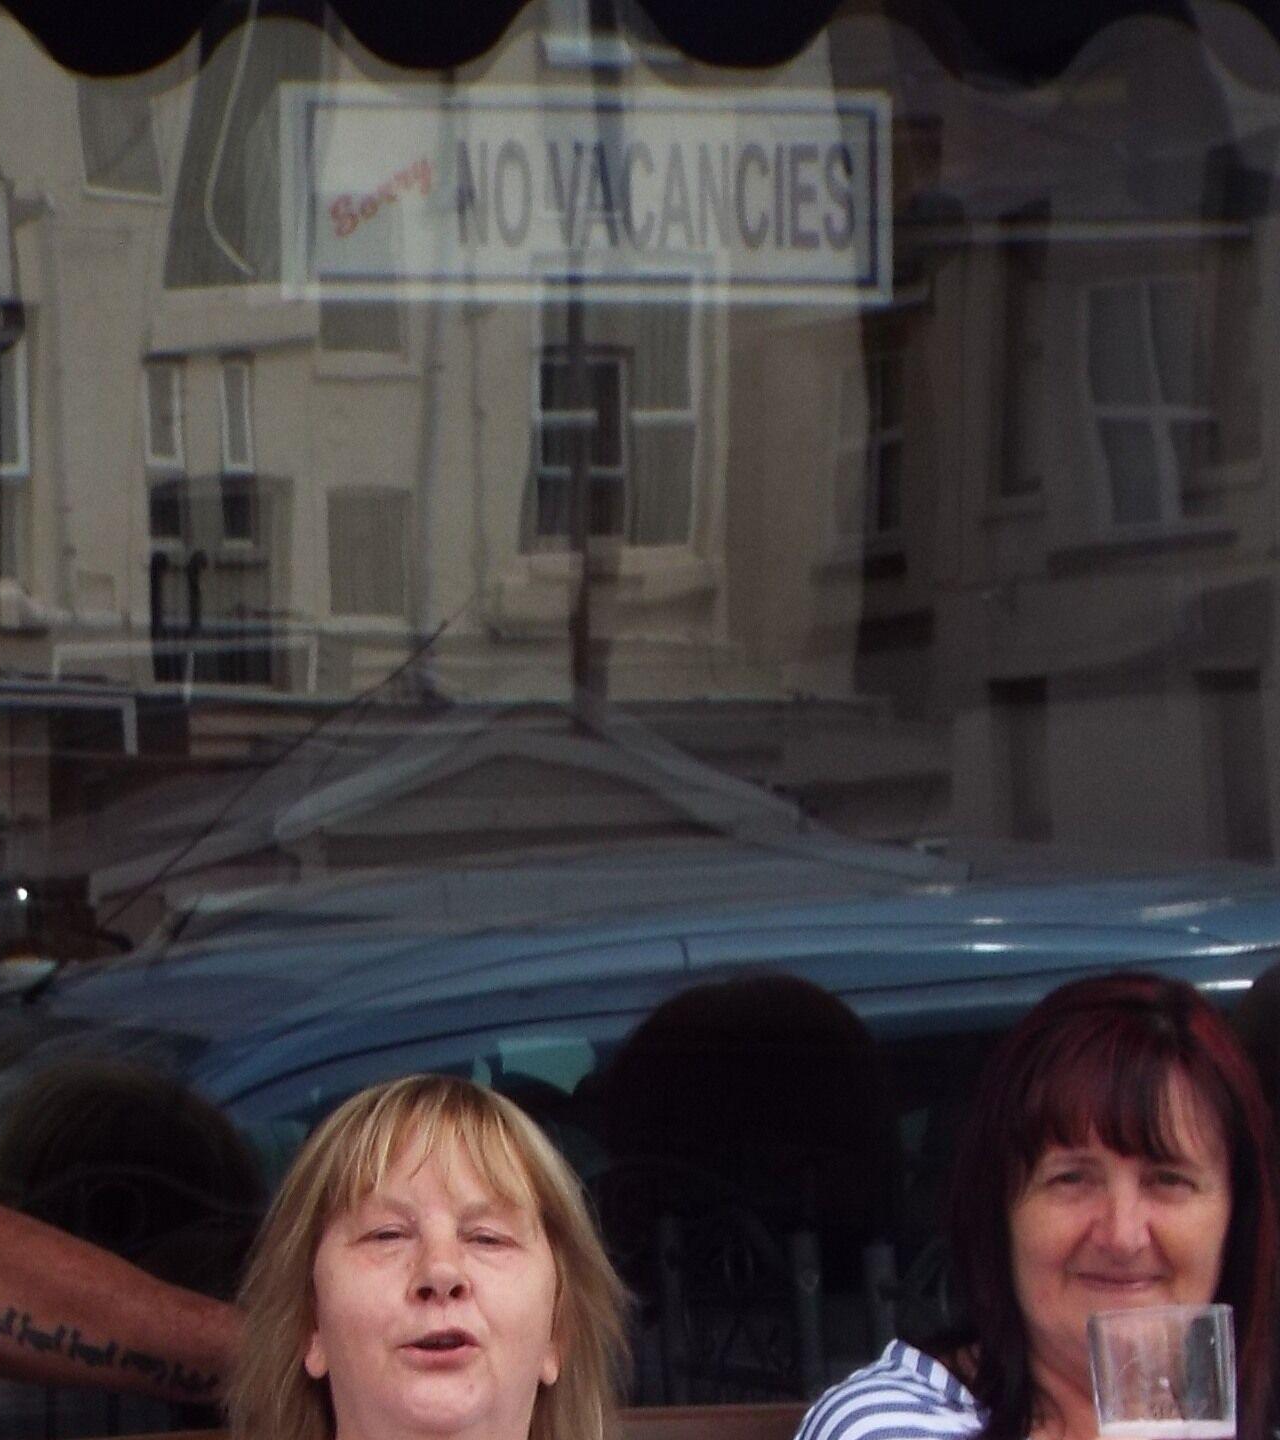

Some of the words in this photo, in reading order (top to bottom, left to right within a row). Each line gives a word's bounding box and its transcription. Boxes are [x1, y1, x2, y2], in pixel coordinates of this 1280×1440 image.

[329, 156, 434, 239] Sorry
[457, 138, 532, 248] NO
[546, 140, 856, 252] VACANCIES
